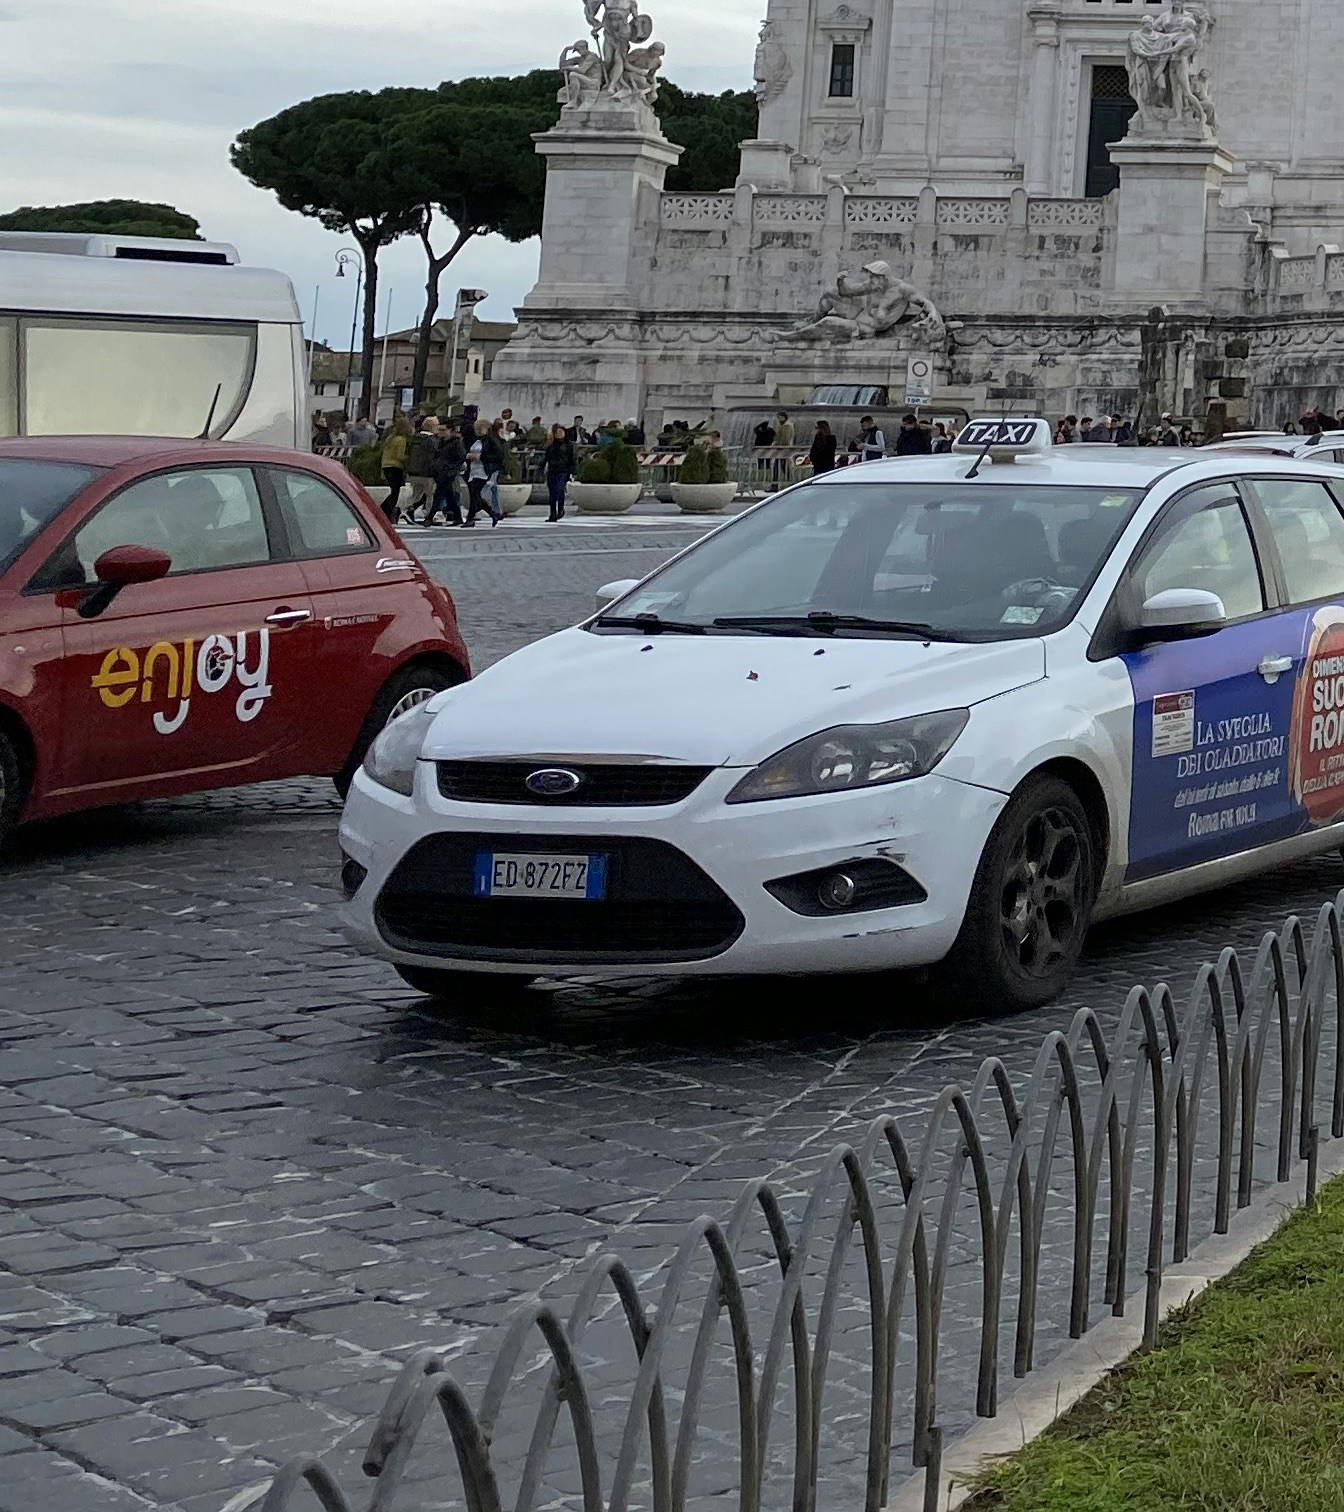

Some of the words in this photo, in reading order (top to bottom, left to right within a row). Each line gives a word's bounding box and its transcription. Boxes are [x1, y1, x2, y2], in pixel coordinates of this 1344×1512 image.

[967, 425, 1032, 442] TAXI
[91, 628, 273, 735] enjoy
[1196, 721, 1215, 746] LA
[1176, 752, 1201, 778] DEI
[1188, 811, 1219, 838] Roma
[493, 860, 518, 888] ED
[525, 861, 587, 890] 872FZ
